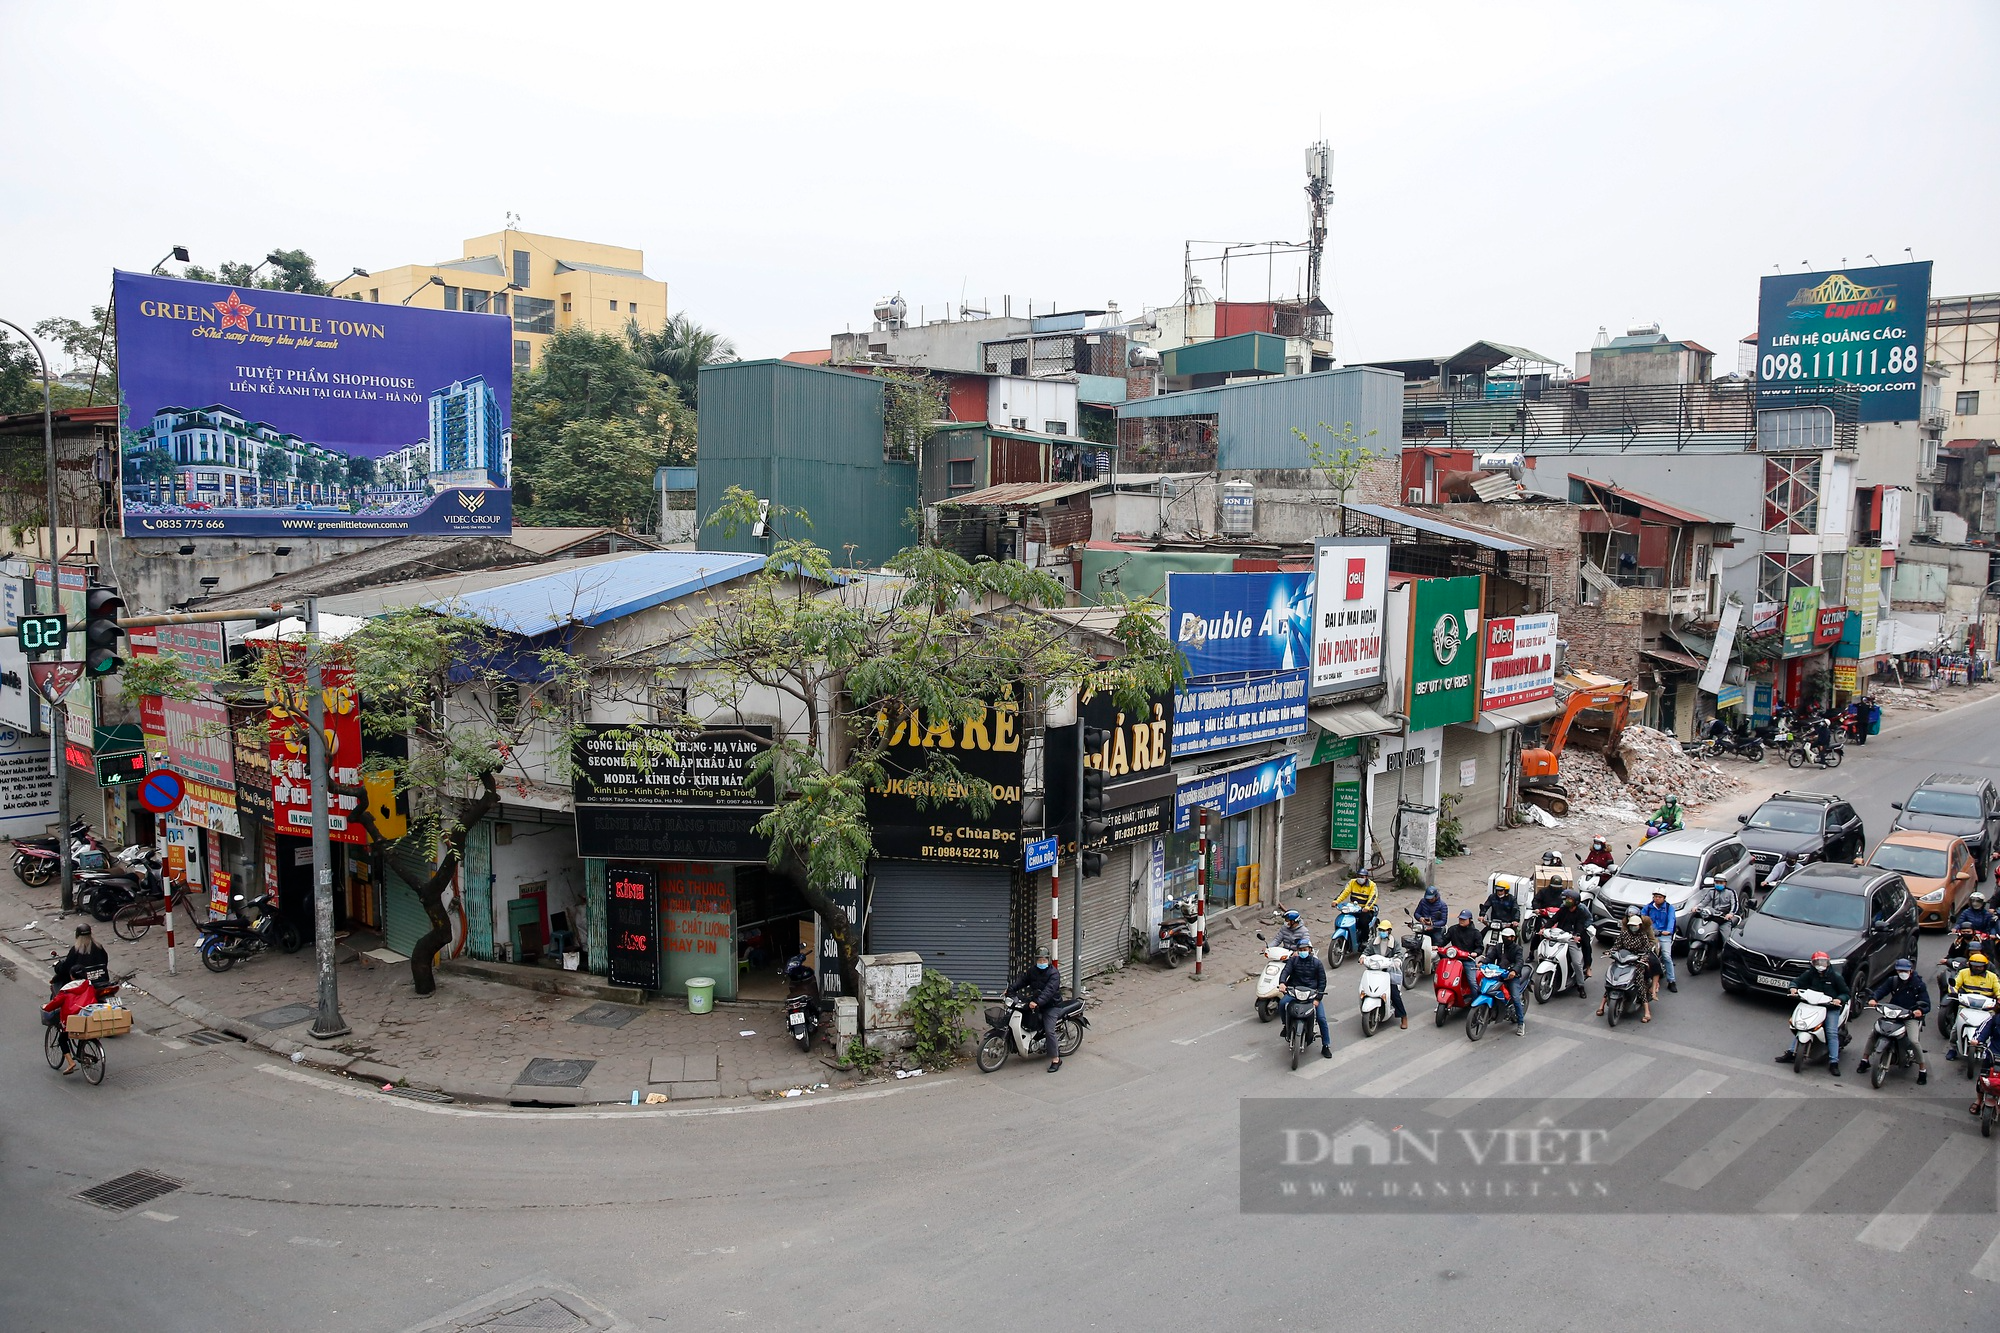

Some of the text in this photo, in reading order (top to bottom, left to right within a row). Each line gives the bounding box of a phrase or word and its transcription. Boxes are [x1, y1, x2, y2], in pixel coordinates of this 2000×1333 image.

[140, 300, 386, 339] GREEN LITTLE TOWN
[1824, 300, 1885, 319] Capital
[192, 325, 224, 340] Nhà
[224, 332, 248, 345] sang
[250, 333, 275, 347] trong
[276, 335, 294, 348] khu
[295, 337, 314, 350] phố
[1772, 326, 1907, 347] LIÊN HỆ QUẢNG CÁO:
[1761, 345, 1918, 381] 098.11111.88
[236, 365, 416, 390] TUYỆT PHẨM SHOPHOUSE
[230, 380, 257, 393] LIỀN
[278, 385, 311, 397] XANH
[313, 388, 330, 400] TẠI
[333, 390, 352, 400] GIA
[354, 389, 377, 401] LÂM
[386, 391, 401, 402] HÀ
[403, 392, 422, 405] NỘI
[155, 519, 225, 529] 0835 775 666
[282, 519, 409, 531] WWW: greenlittletown.com.vn
[443, 515, 501, 525] VIDEC GROUP
[1348, 572, 1364, 584] deli
[1179, 609, 1273, 642] Double A
[1324, 605, 1378, 629] ĐẠI LÝ MAI HOÀN
[22, 618, 61, 648] 02
[1318, 627, 1380, 667] VĂN PHÒNG PHẨM
[1198, 686, 1231, 710] PHÒNG
[1232, 680, 1257, 706] PHẨM
[1258, 679, 1283, 703] XUÂN
[164, 708, 195, 753] PHOTO
[1184, 718, 1200, 737] BUÔN
[1204, 715, 1217, 733] BÁN
[1217, 712, 1224, 731] LẺ
[1267, 707, 1280, 722] DÙNG
[1290, 703, 1306, 719] PHÒNG
[587, 740, 613, 753] GỌNG
[713, 742, 728, 755] MẠ
[730, 739, 758, 753] VÀNG
[1131, 703, 1167, 772] RẺ
[695, 753, 725, 769] KHẨU
[727, 756, 742, 769] ÂU
[604, 768, 743, 786] MODEL KÍNH CỔ KÍNH MÁT
[1229, 769, 1283, 804] Double A
[676, 788, 689, 796] Hai
[1114, 811, 1122, 825] RẺ
[1147, 803, 1160, 818] NHẤT
[956, 826, 990, 840] Chùa
[1148, 821, 1159, 833] 222
[921, 845, 1000, 860] ĐT:0984 522 314
[1028, 850, 1054, 867] CHÙA BỘC
[615, 877, 645, 900] KÍNH
[663, 937, 717, 955] THAY PIN
[823, 933, 839, 958] SỬA
